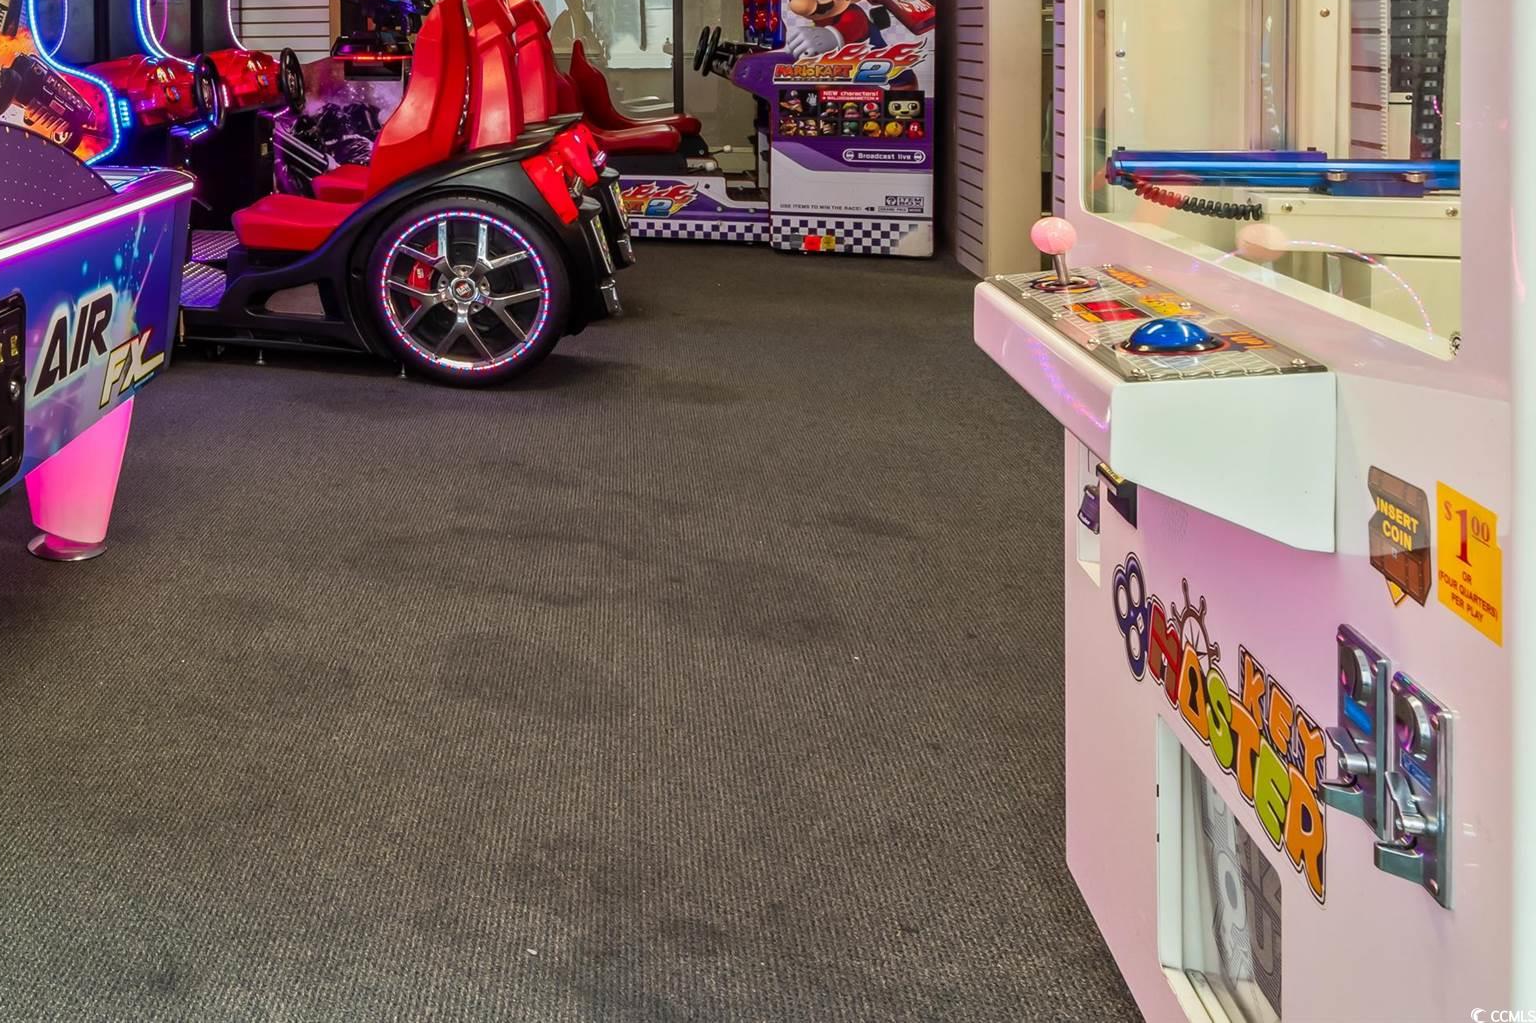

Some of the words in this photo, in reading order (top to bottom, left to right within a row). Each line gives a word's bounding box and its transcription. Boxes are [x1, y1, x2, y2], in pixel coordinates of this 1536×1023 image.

[854, 59, 894, 84] 2
[857, 152, 896, 160] Broadcast
[645, 197, 673, 217] 2
[32, 291, 114, 398] AIR
[98, 328, 165, 410] FX
[1376, 496, 1419, 534] INSERT
[1382, 519, 1413, 552] COIN
[1462, 571, 1472, 585] OR
[1450, 592, 1465, 610] PER
[1466, 604, 1484, 623] PLAY
[1242, 653, 1325, 792] KEY
